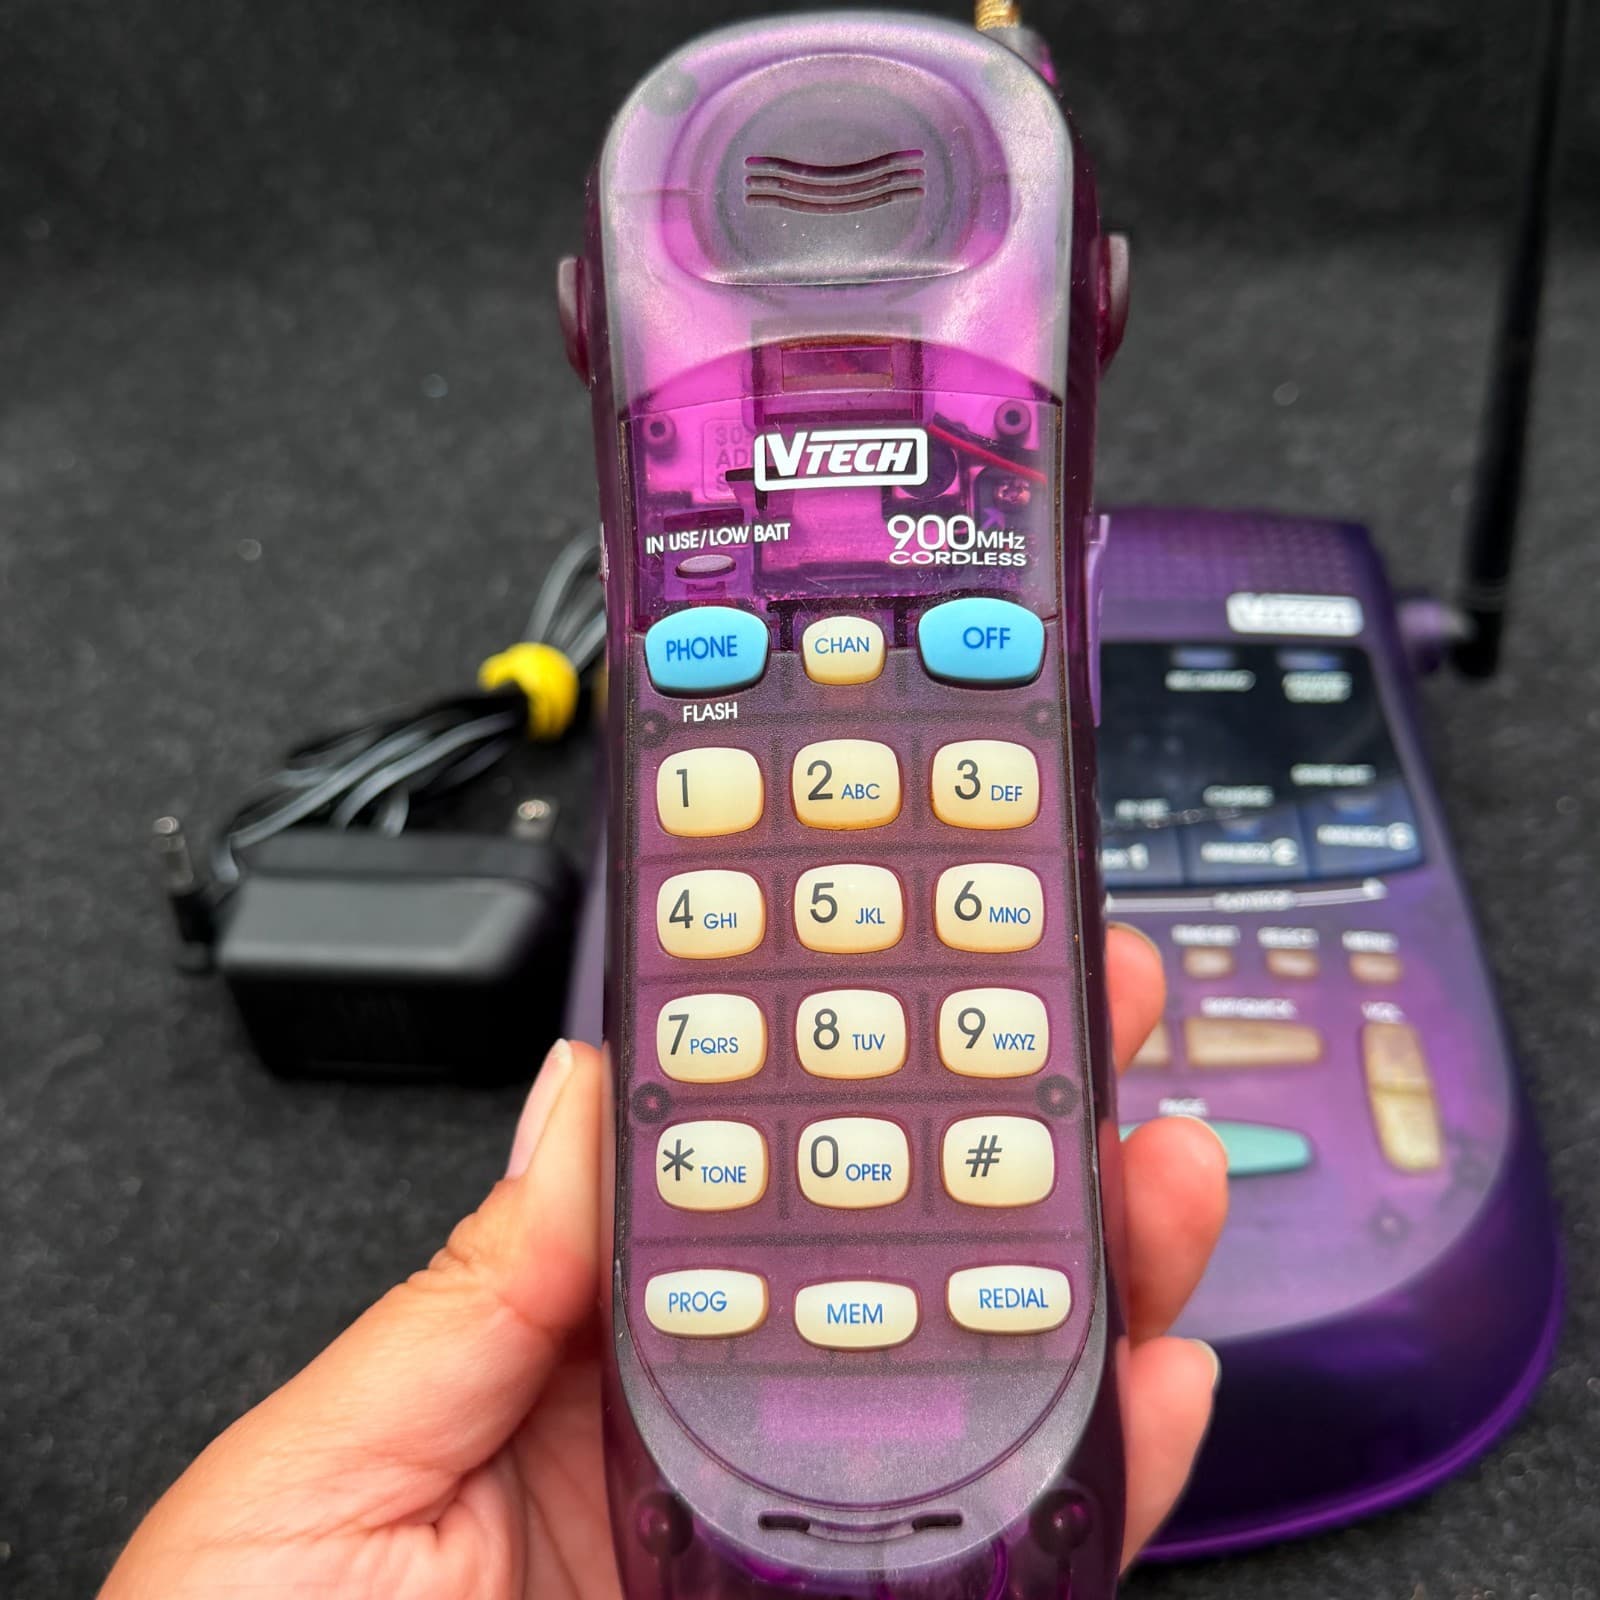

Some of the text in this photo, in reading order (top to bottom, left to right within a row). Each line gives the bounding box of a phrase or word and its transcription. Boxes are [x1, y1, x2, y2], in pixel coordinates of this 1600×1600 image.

[765, 432, 913, 477] VTECH
[645, 535, 665, 555] IN
[753, 522, 791, 543] BATT
[888, 551, 1028, 567] CORDLESS
[665, 634, 738, 663] PHONE
[814, 636, 870, 655] CHAN
[962, 626, 1011, 650] OFF
[682, 701, 738, 723] FLASH
[676, 768, 690, 808] 1
[807, 759, 881, 801] 2 ABC
[954, 759, 1023, 802] 3 DEF
[668, 889, 737, 930] 4 GHI
[809, 881, 886, 925] 5 JKL
[953, 880, 1031, 925] 6 MNO
[668, 1013, 739, 1056] 7 PQRS
[813, 1008, 886, 1051] 8 TUV
[957, 1007, 1036, 1051] 9 WXYZ
[700, 1165, 747, 1184] TONE
[810, 1135, 892, 1182] 0 OPER
[965, 1134, 1003, 1178] #
[668, 1290, 728, 1313] PROG
[827, 1303, 883, 1325] MEM
[979, 1287, 1049, 1309] REDIAL
